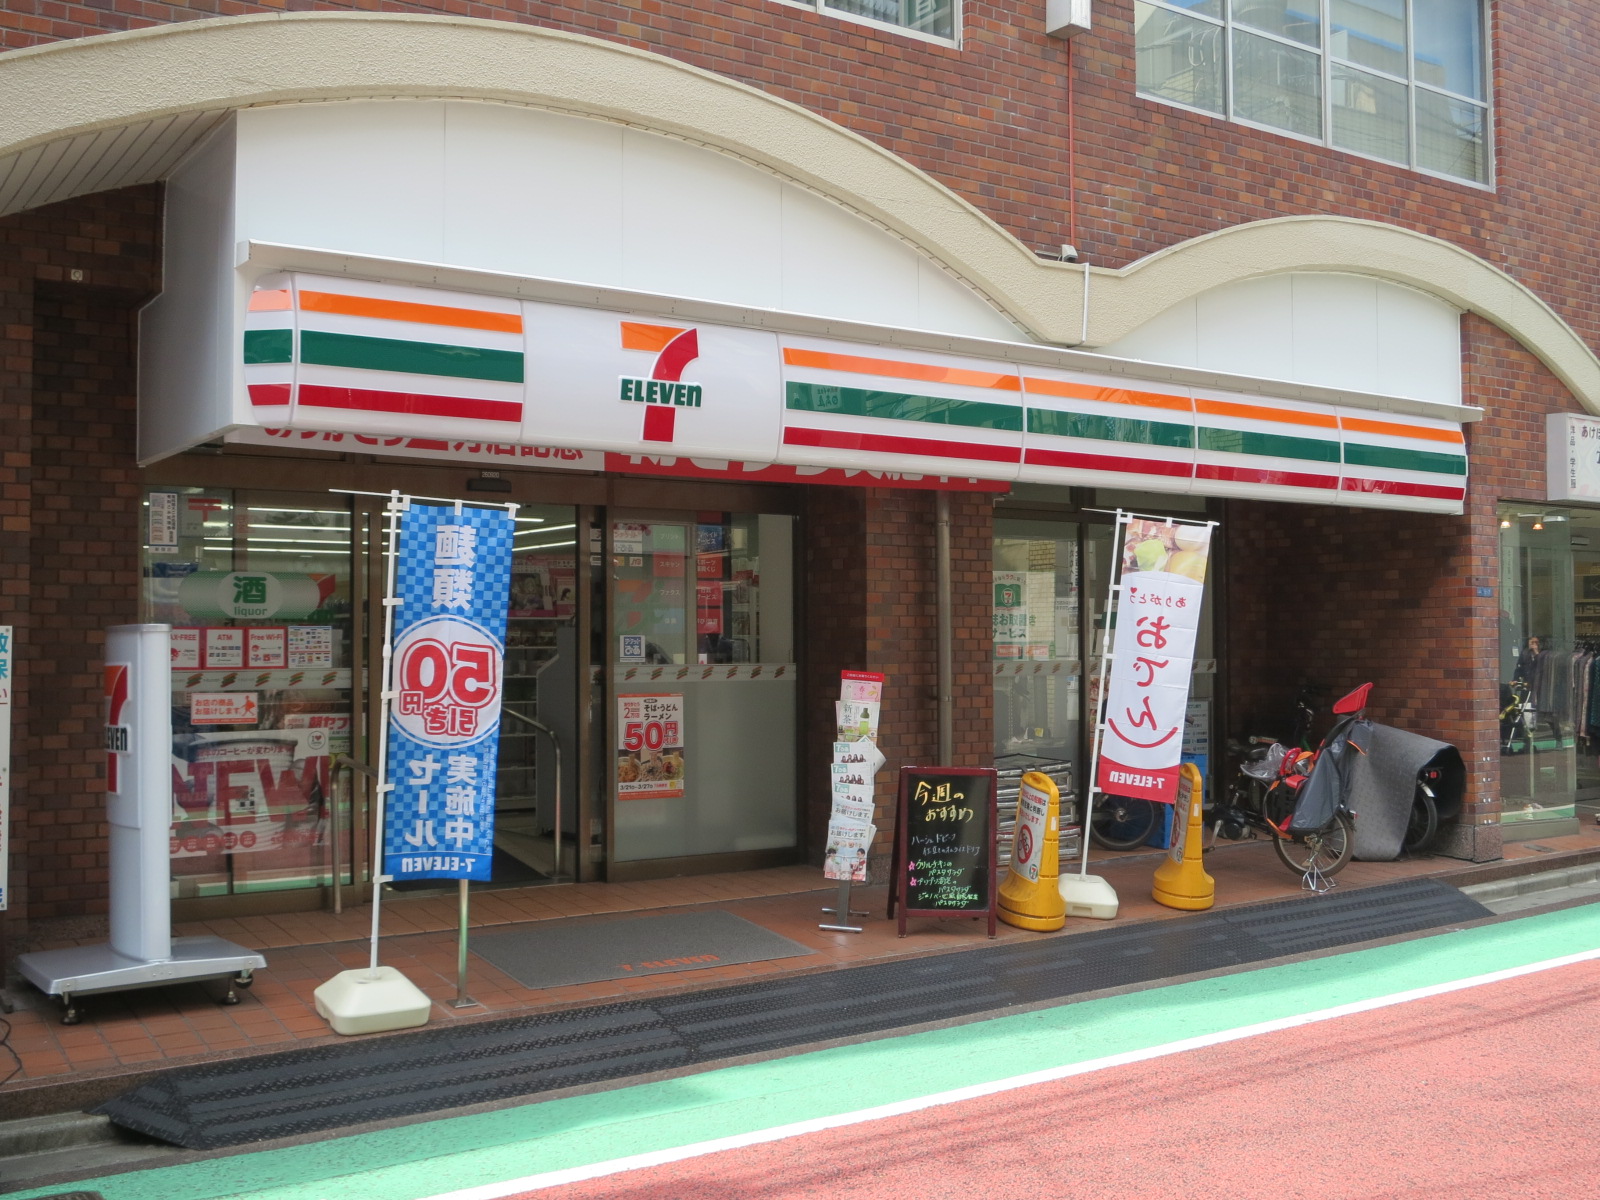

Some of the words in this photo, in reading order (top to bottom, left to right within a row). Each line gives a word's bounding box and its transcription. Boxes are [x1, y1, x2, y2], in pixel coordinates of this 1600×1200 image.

[620, 378, 703, 408] ELEVEn
[233, 576, 267, 603] 酒
[234, 606, 268, 617] liquor
[644, 713, 672, 721] ラーメン
[624, 721, 664, 751] 50
[914, 781, 965, 805] 今週の
[925, 805, 975, 823] おすすめ
